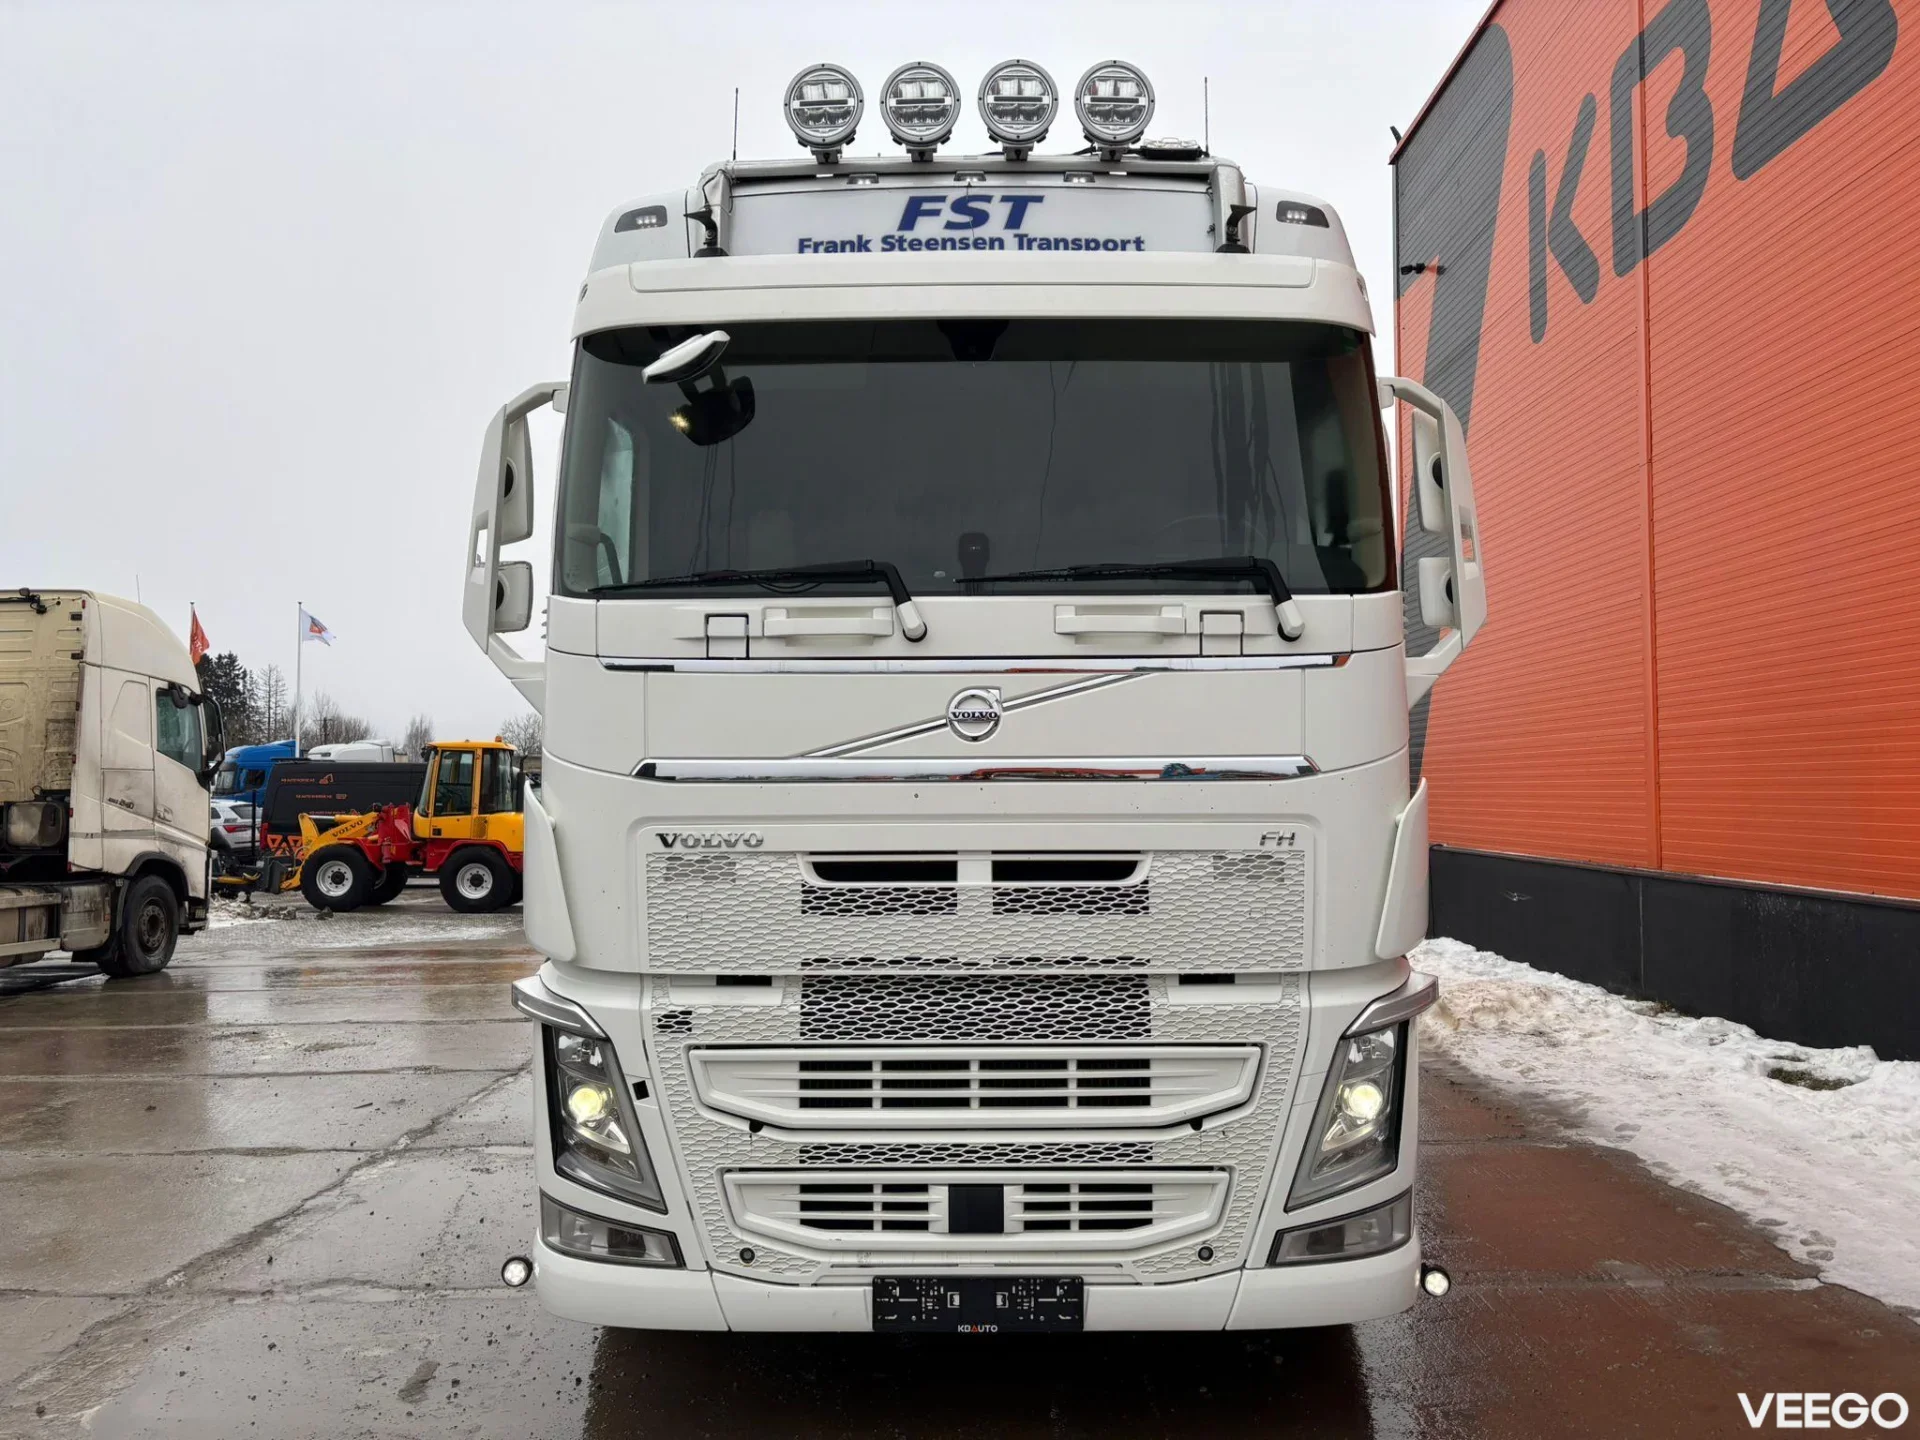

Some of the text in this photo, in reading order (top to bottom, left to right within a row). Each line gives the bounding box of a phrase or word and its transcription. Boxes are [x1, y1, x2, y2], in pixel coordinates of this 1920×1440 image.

[897, 195, 1045, 231] FST
[798, 233, 1146, 254] Frank Steensen Transport
[951, 711, 998, 719] VOLVO
[332, 820, 364, 838] VOLVO
[655, 832, 764, 848] VOLVO
[1259, 830, 1296, 846] FH
